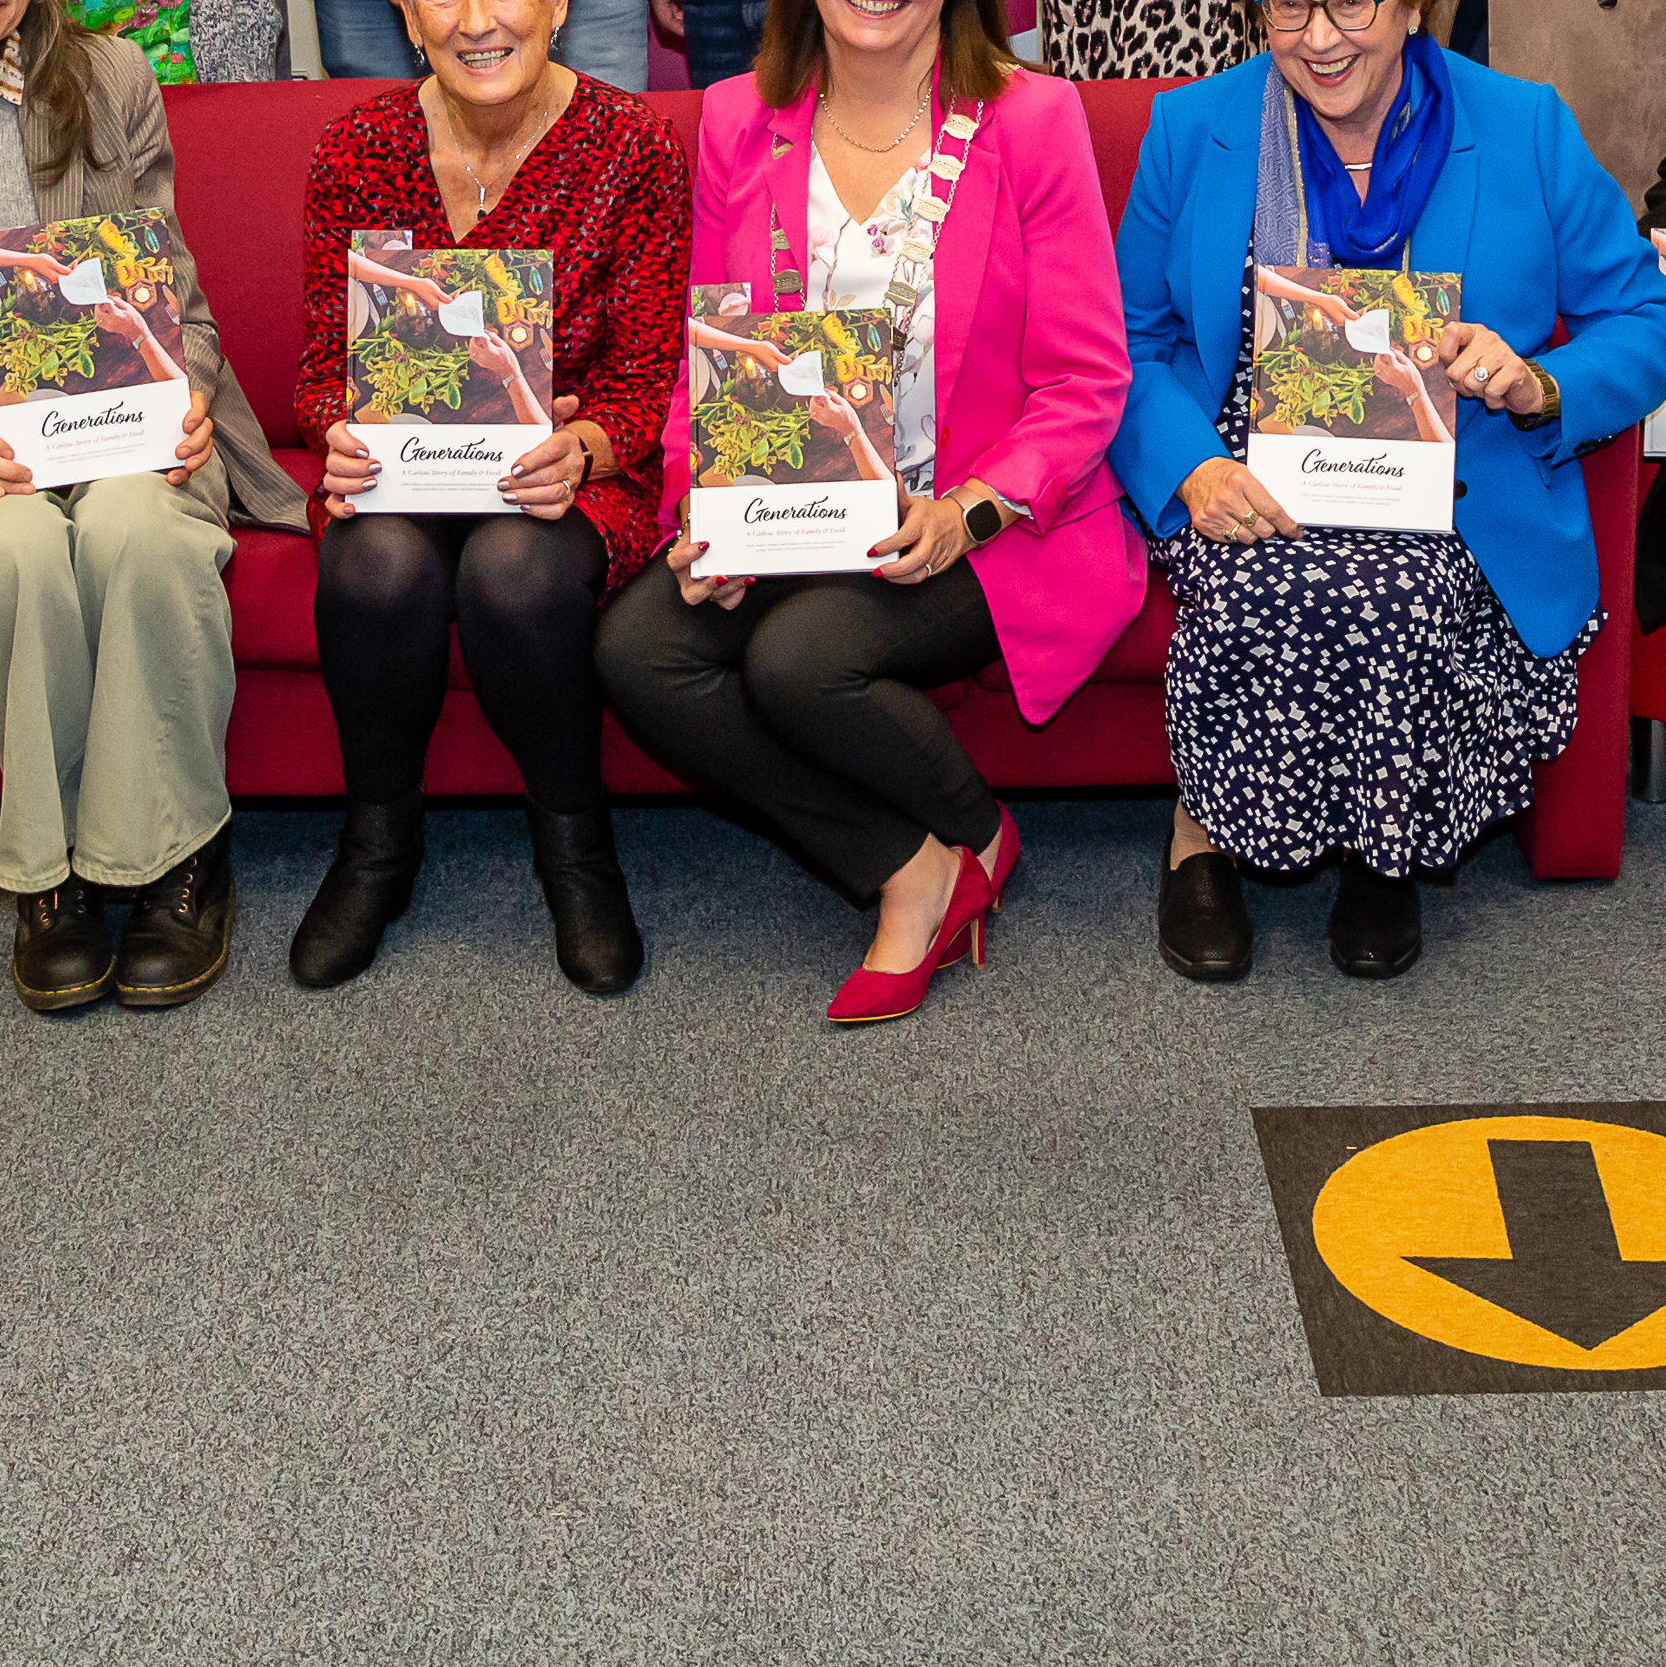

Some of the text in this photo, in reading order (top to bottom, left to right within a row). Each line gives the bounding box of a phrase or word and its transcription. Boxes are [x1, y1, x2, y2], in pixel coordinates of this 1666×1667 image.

[42, 401, 145, 437] Generations
[400, 437, 504, 462] Generations
[1302, 449, 1405, 477] Generations
[744, 496, 847, 524] Generations
